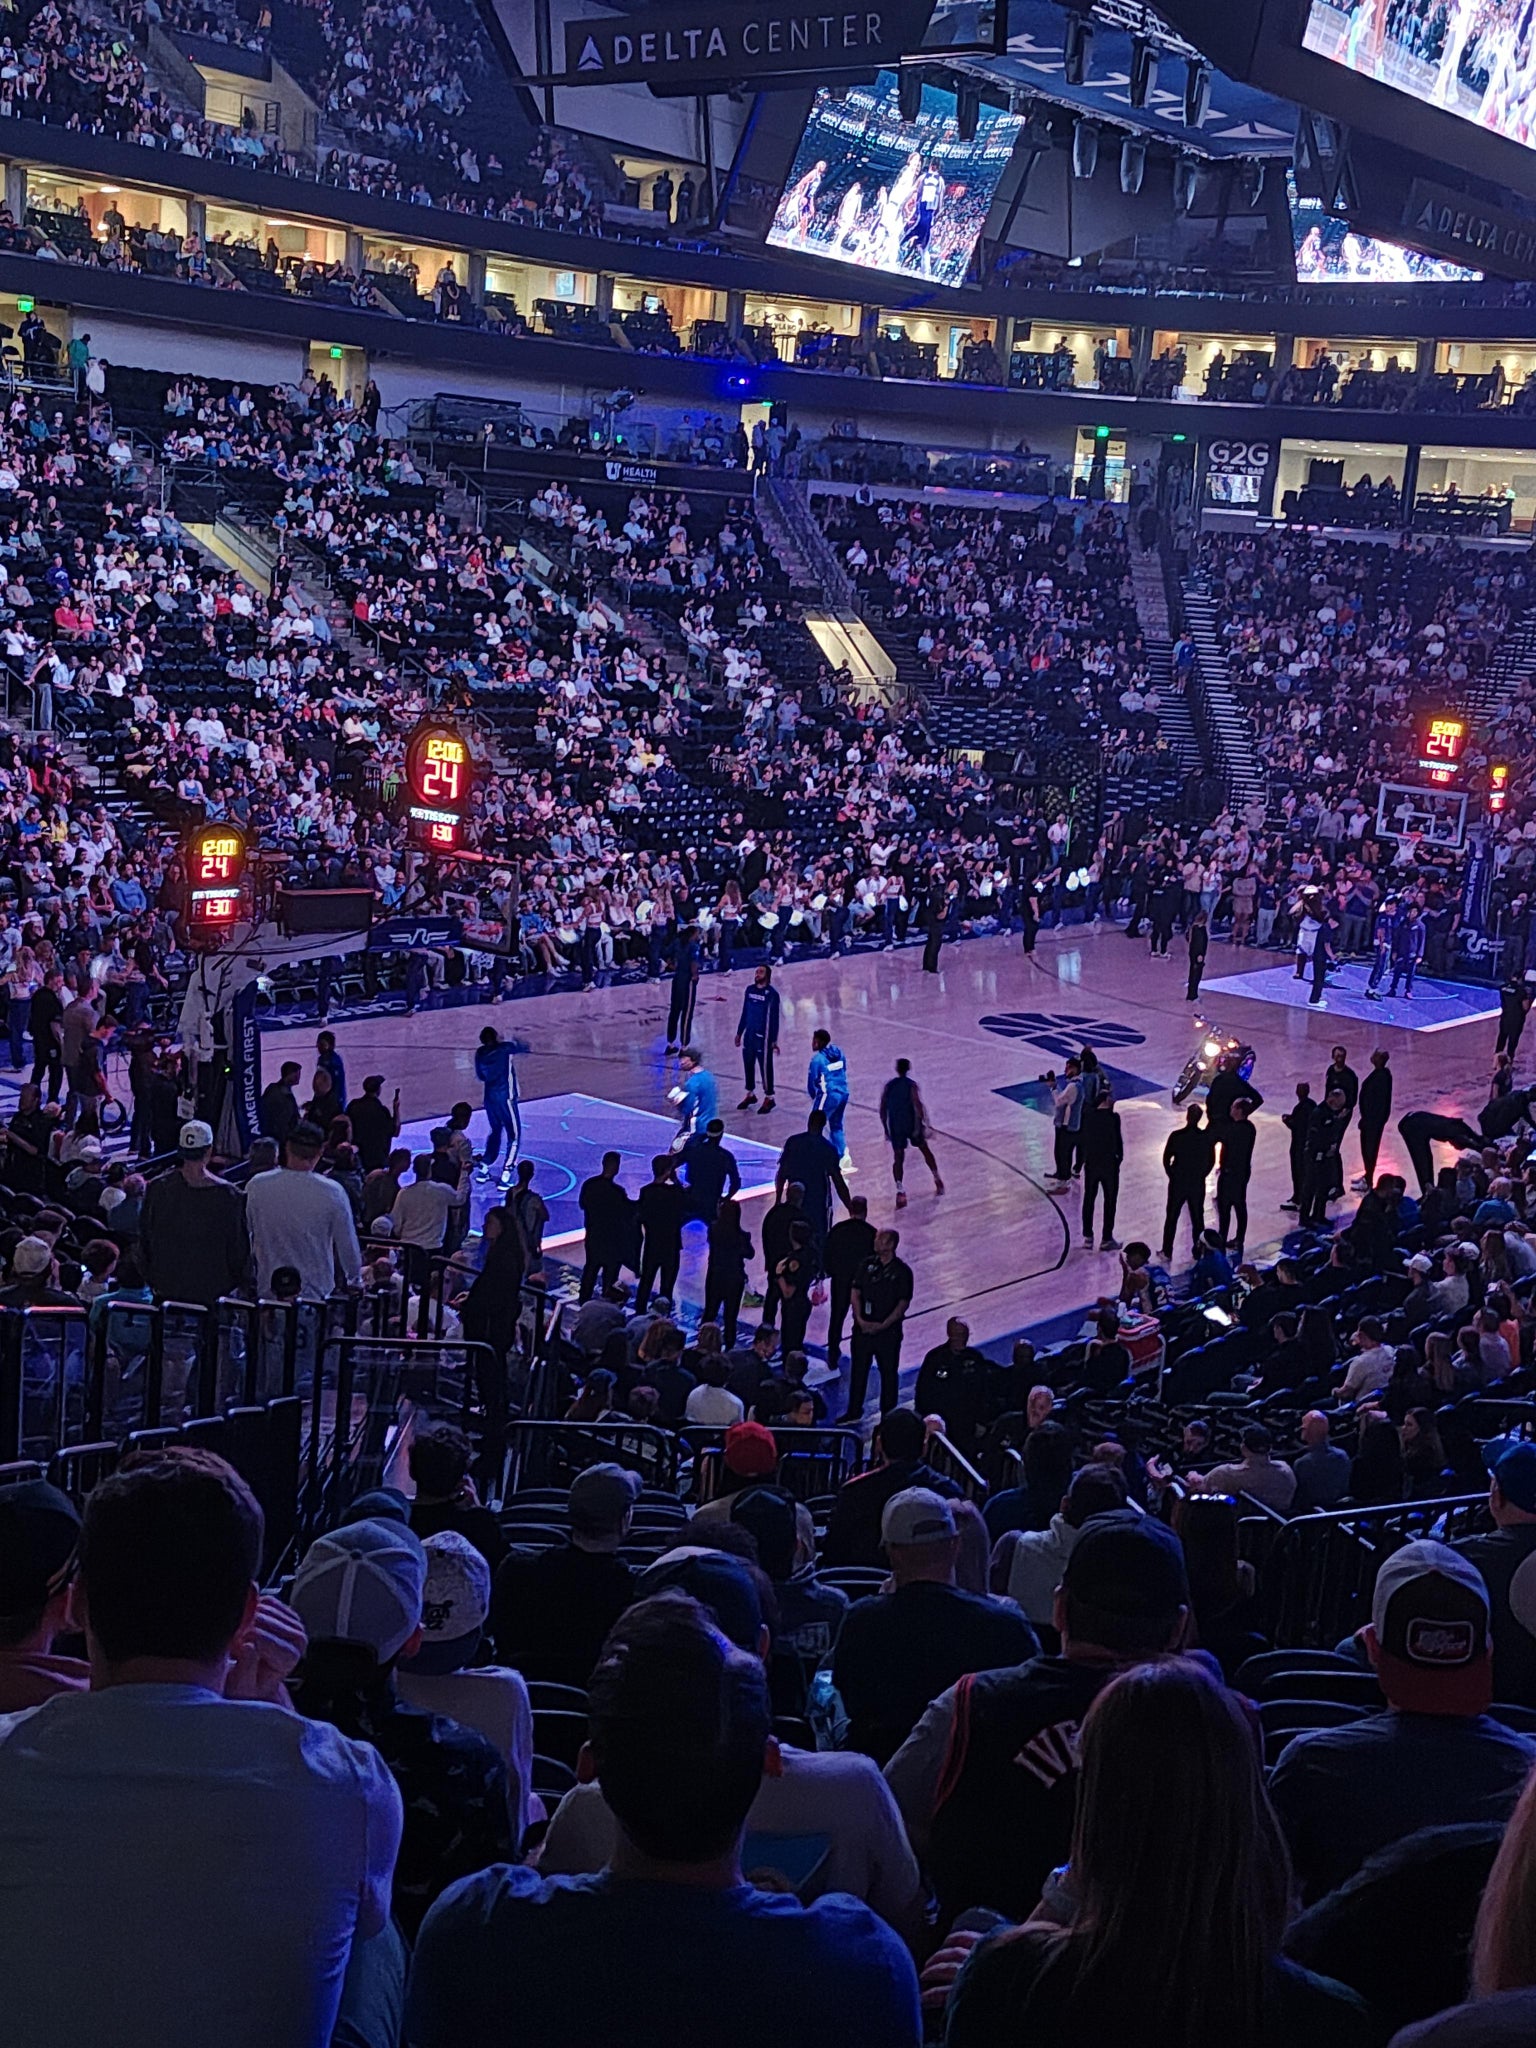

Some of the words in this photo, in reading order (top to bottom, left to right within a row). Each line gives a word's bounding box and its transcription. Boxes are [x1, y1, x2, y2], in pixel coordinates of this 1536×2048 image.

[614, 27, 727, 65] DELTA
[742, 13, 882, 54] CENTER
[1438, 206, 1497, 250] DELTA
[1208, 441, 1269, 466] G2G
[623, 467, 657, 479] HEALTH
[1426, 733, 1456, 757] 24
[423, 759, 458, 799] 24
[201, 857, 230, 879] 24
[243, 1016, 255, 1062] FIRST
[243, 1063, 261, 1135] AMERICA
[186, 1133, 195, 1146] C
